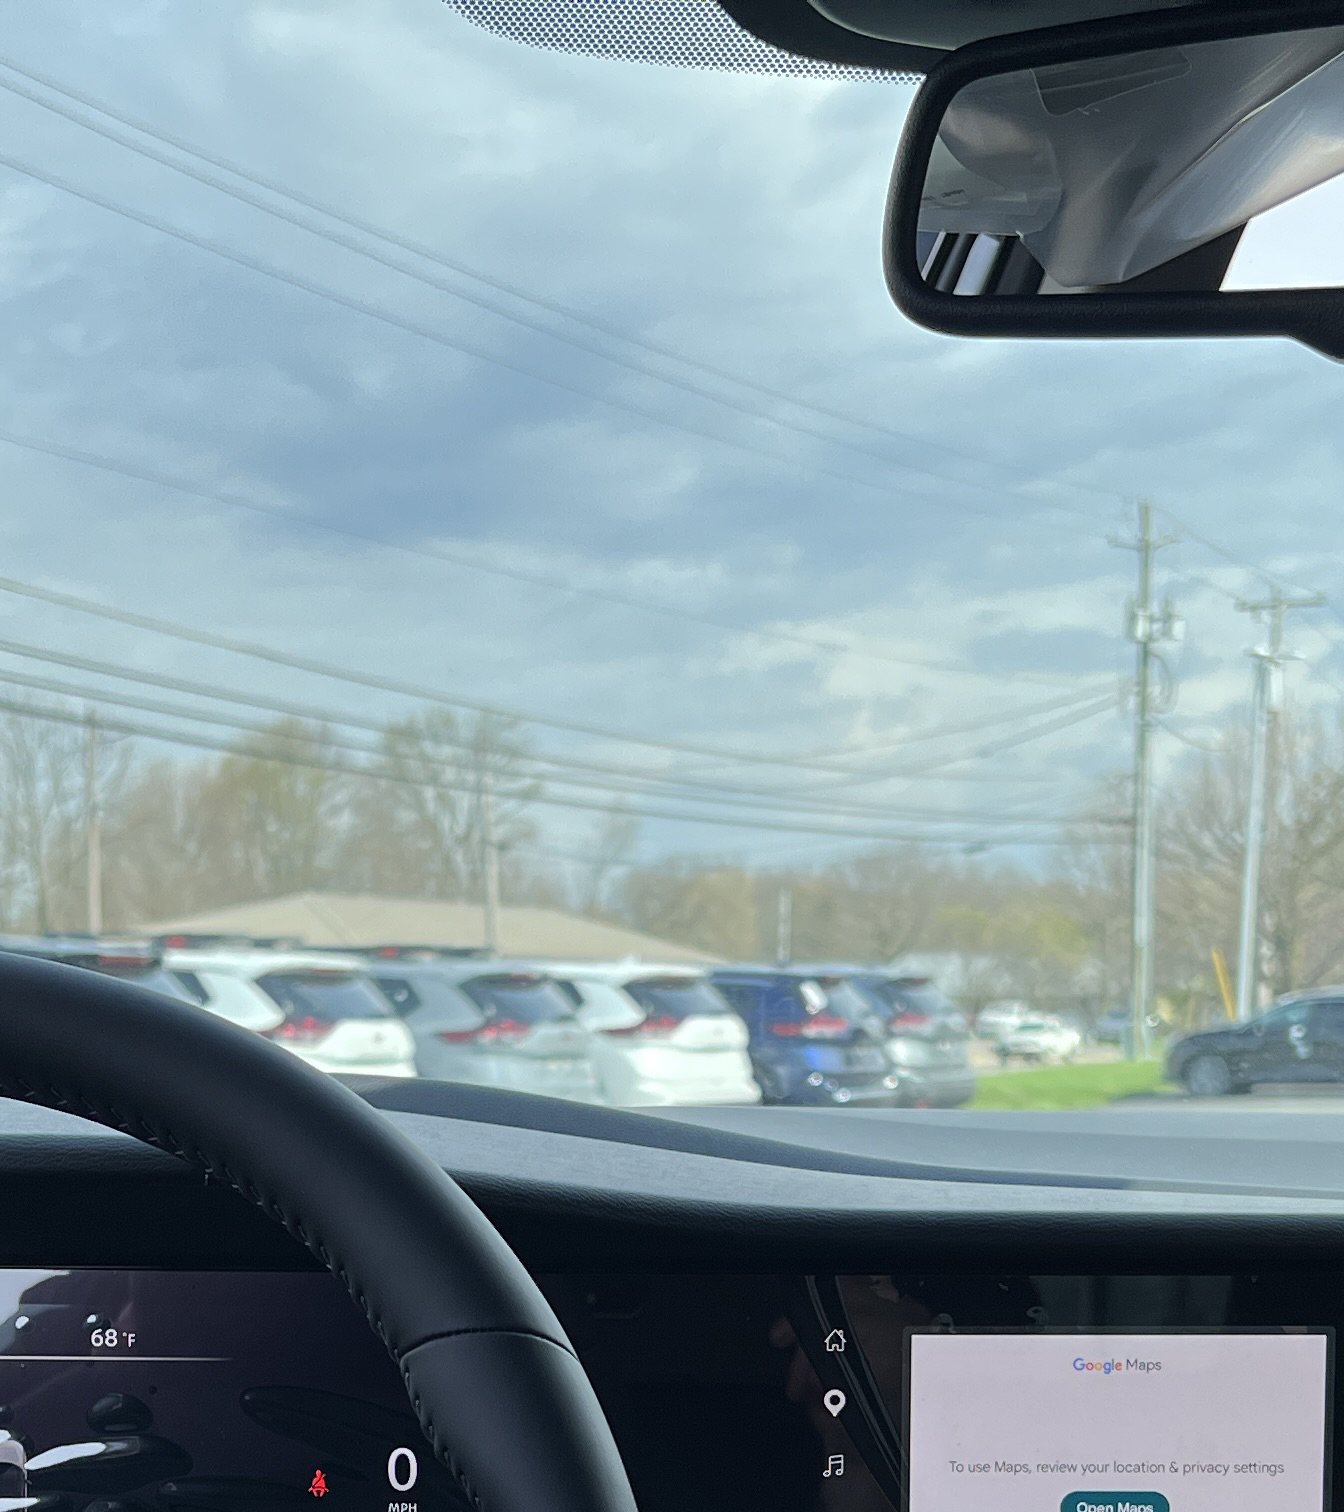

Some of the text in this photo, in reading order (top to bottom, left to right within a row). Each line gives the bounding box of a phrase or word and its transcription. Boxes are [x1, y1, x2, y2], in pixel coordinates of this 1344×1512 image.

[90, 1328, 118, 1348] 68
[1072, 1357, 1162, 1375] Google Maps
[387, 1447, 418, 1492] 0
[949, 1460, 1285, 1477] To use Maps, review your location & privacy settings
